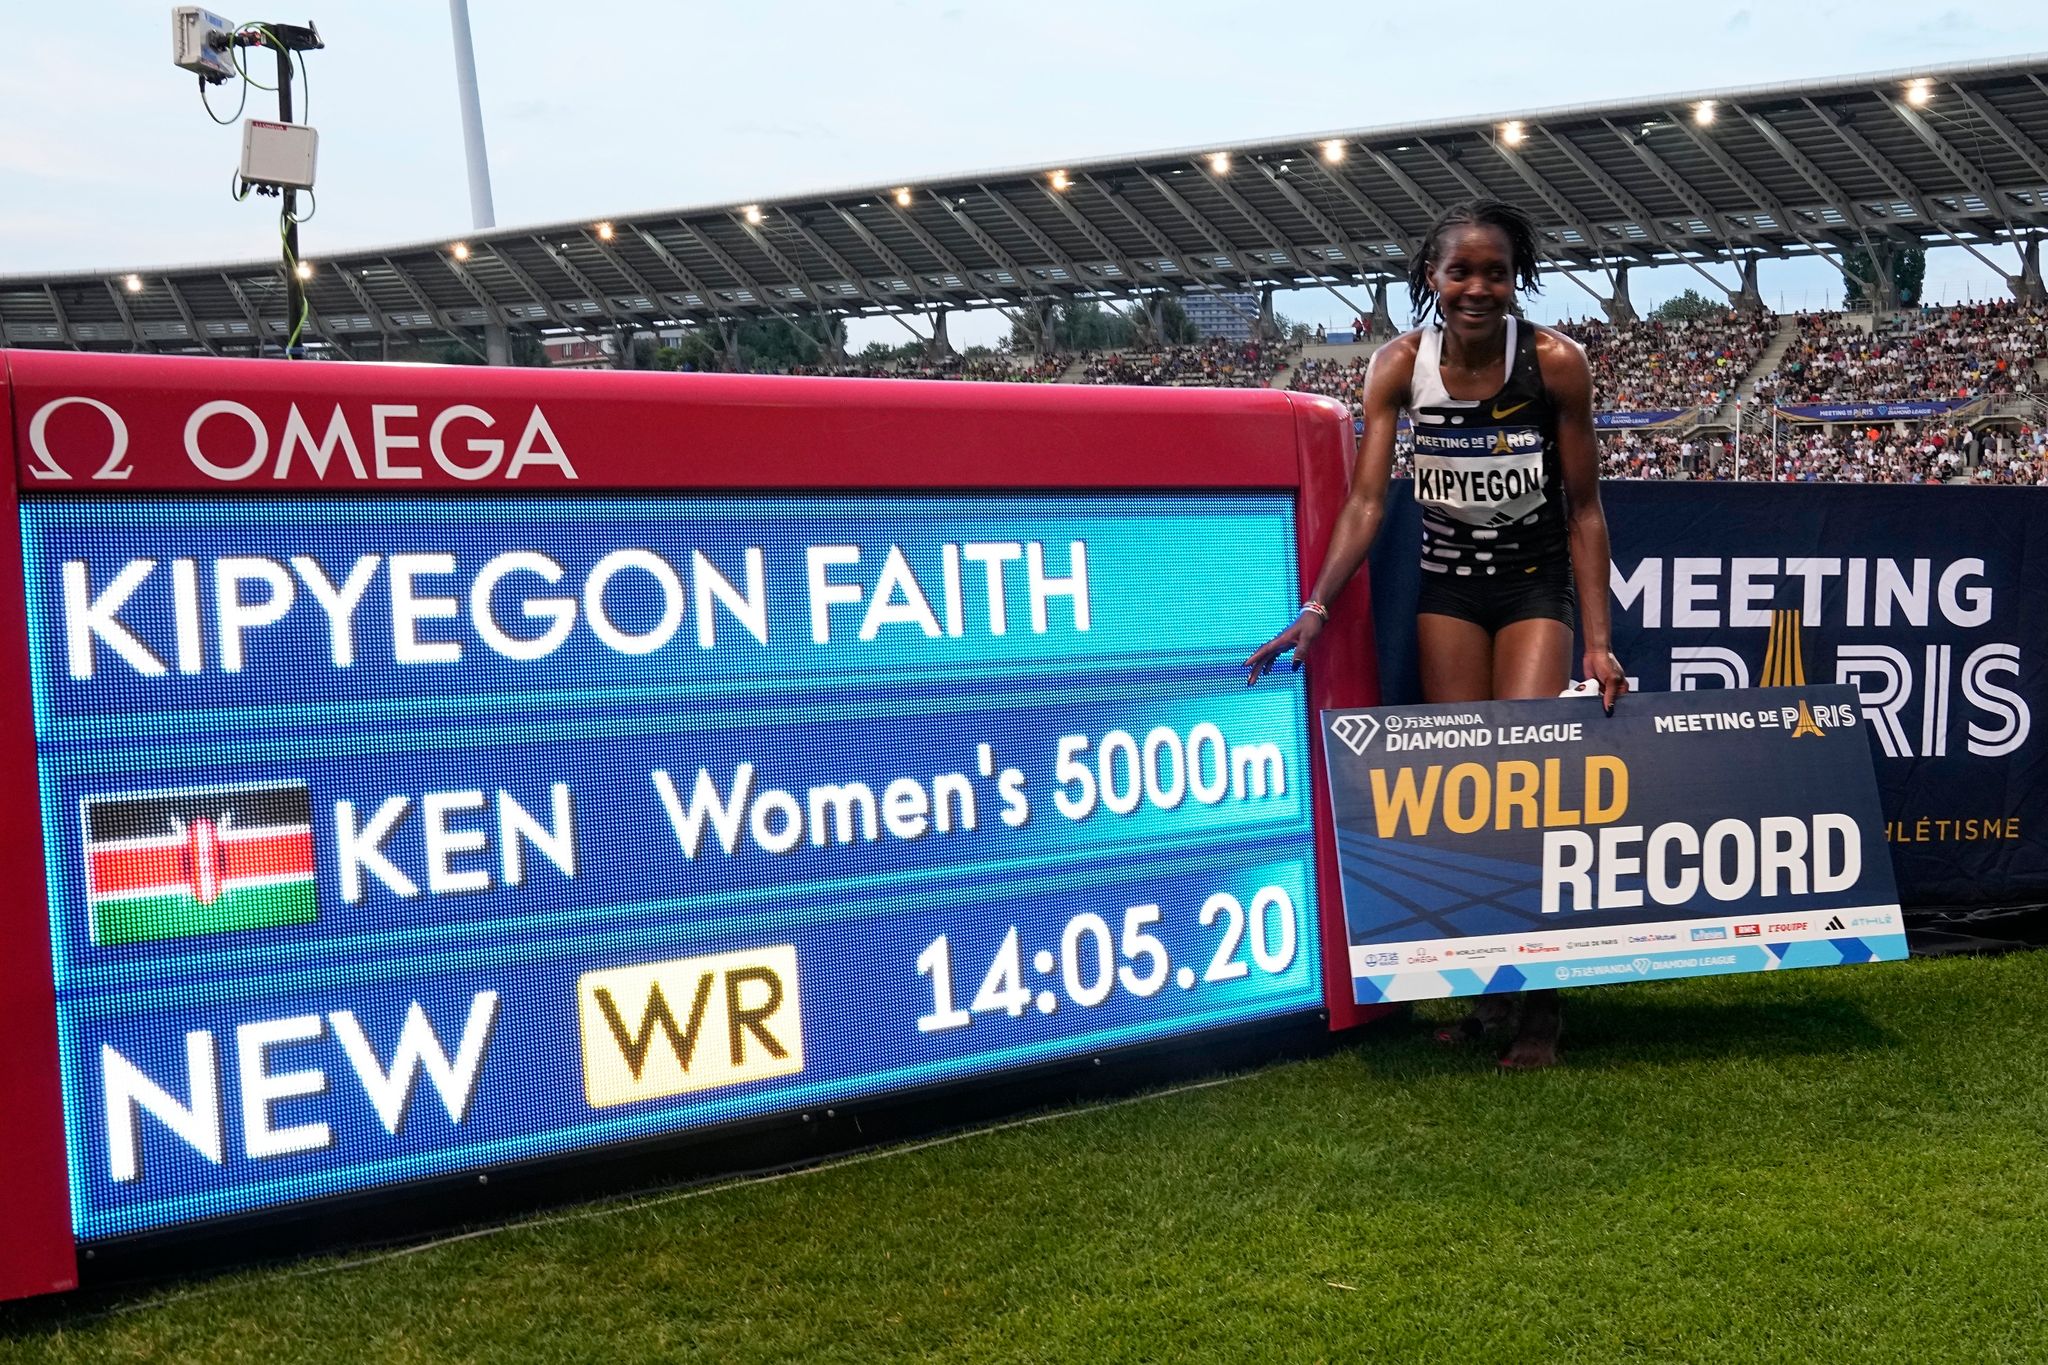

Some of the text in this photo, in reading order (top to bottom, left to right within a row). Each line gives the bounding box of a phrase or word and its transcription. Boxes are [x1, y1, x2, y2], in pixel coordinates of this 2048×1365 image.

[183, 399, 579, 481] OMEGA
[1416, 430, 1537, 454] MEETING DE PARIS
[1418, 467, 1540, 502] KIPYEGON
[62, 540, 1092, 682] KIPYEGON FAITH
[1610, 557, 1993, 629] MEETING
[1385, 723, 1583, 752] DIAMOND LEAGUE
[1433, 713, 1484, 726] WANDA
[1654, 699, 1857, 739] MEETING DE PARIS
[335, 722, 1287, 905] KEN Women's 5000m
[1369, 754, 1630, 839] WORLD
[1541, 812, 1863, 914] RECORD
[1652, 958, 1697, 971] DIAMOND
[1699, 955, 1737, 967] LEAGUE
[101, 884, 1297, 1184] NEW WR 14:05.20
